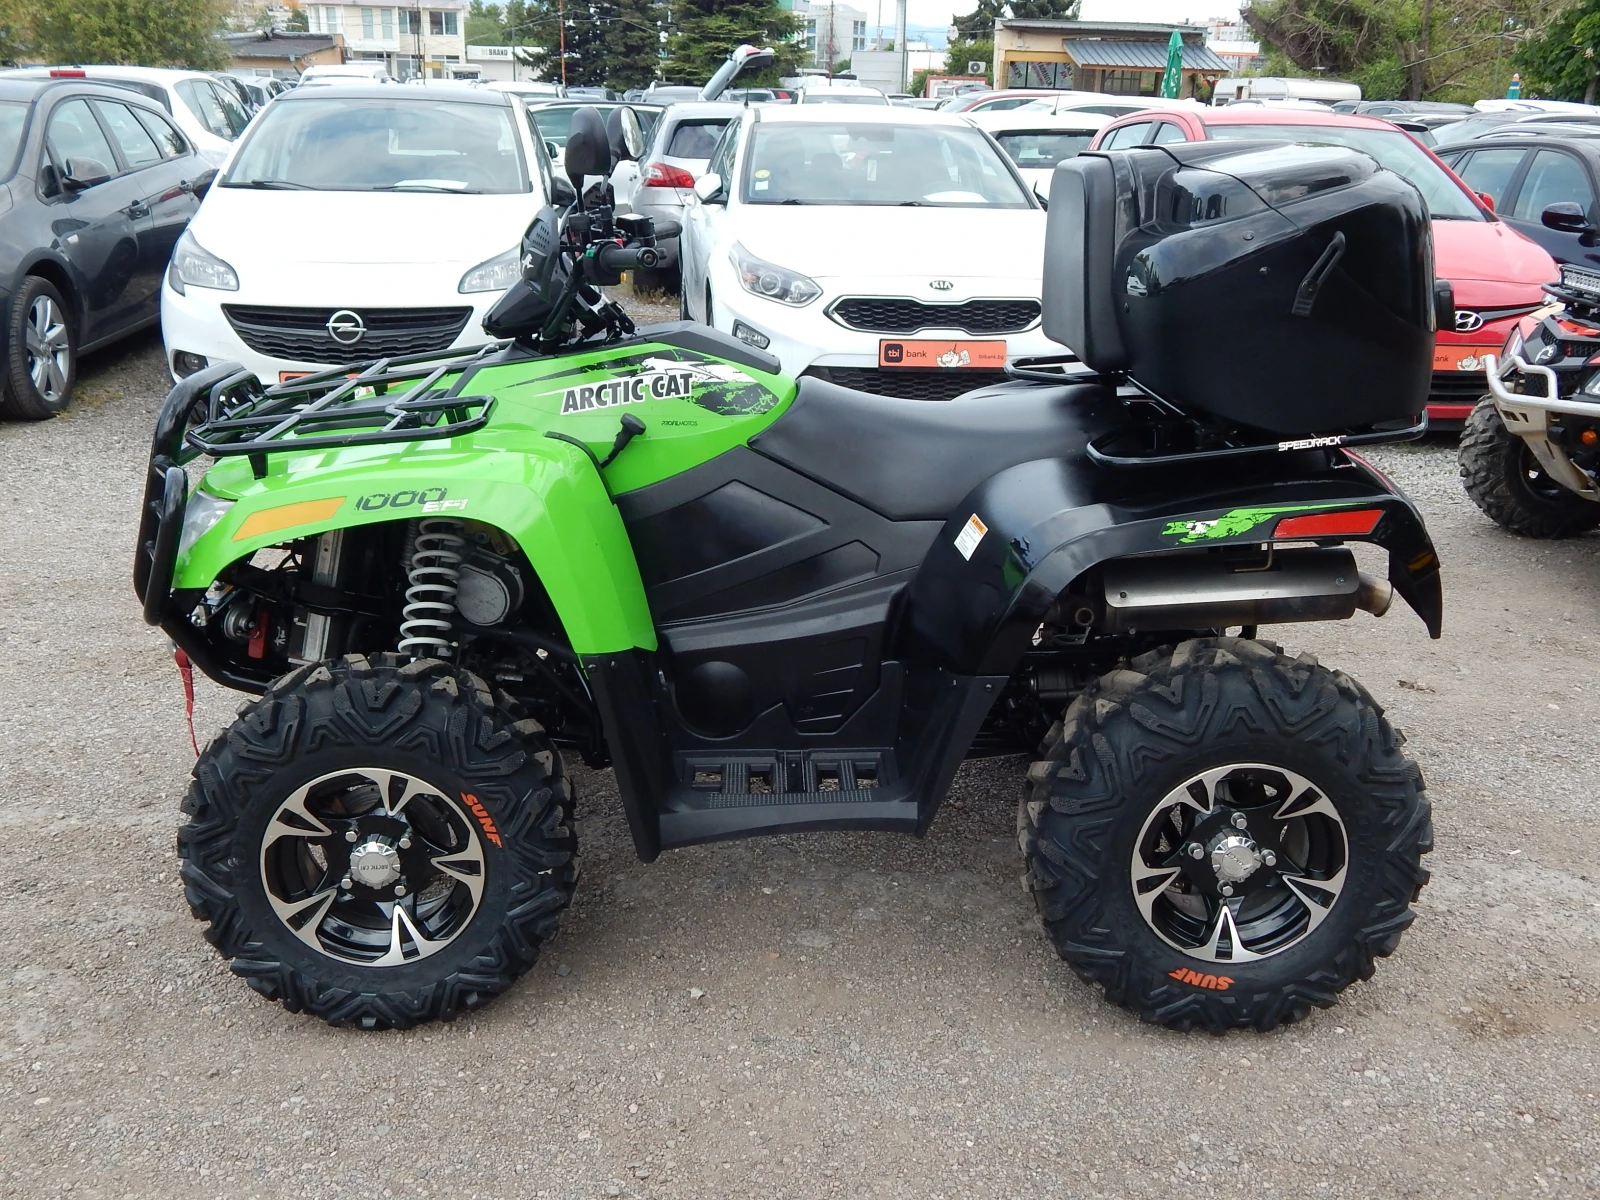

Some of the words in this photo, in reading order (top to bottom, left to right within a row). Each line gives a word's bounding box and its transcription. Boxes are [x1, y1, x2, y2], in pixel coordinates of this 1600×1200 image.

[931, 280, 952, 289] KIA
[887, 349, 900, 358] tbi
[906, 350, 927, 358] bank
[562, 378, 644, 414] ARCTIC
[651, 373, 693, 399] CAT
[1278, 436, 1342, 451] SPEEDRACK
[354, 487, 448, 511] 1000
[421, 499, 469, 513] EFI
[460, 791, 503, 849] SUNF
[1167, 967, 1236, 991] SUNF
